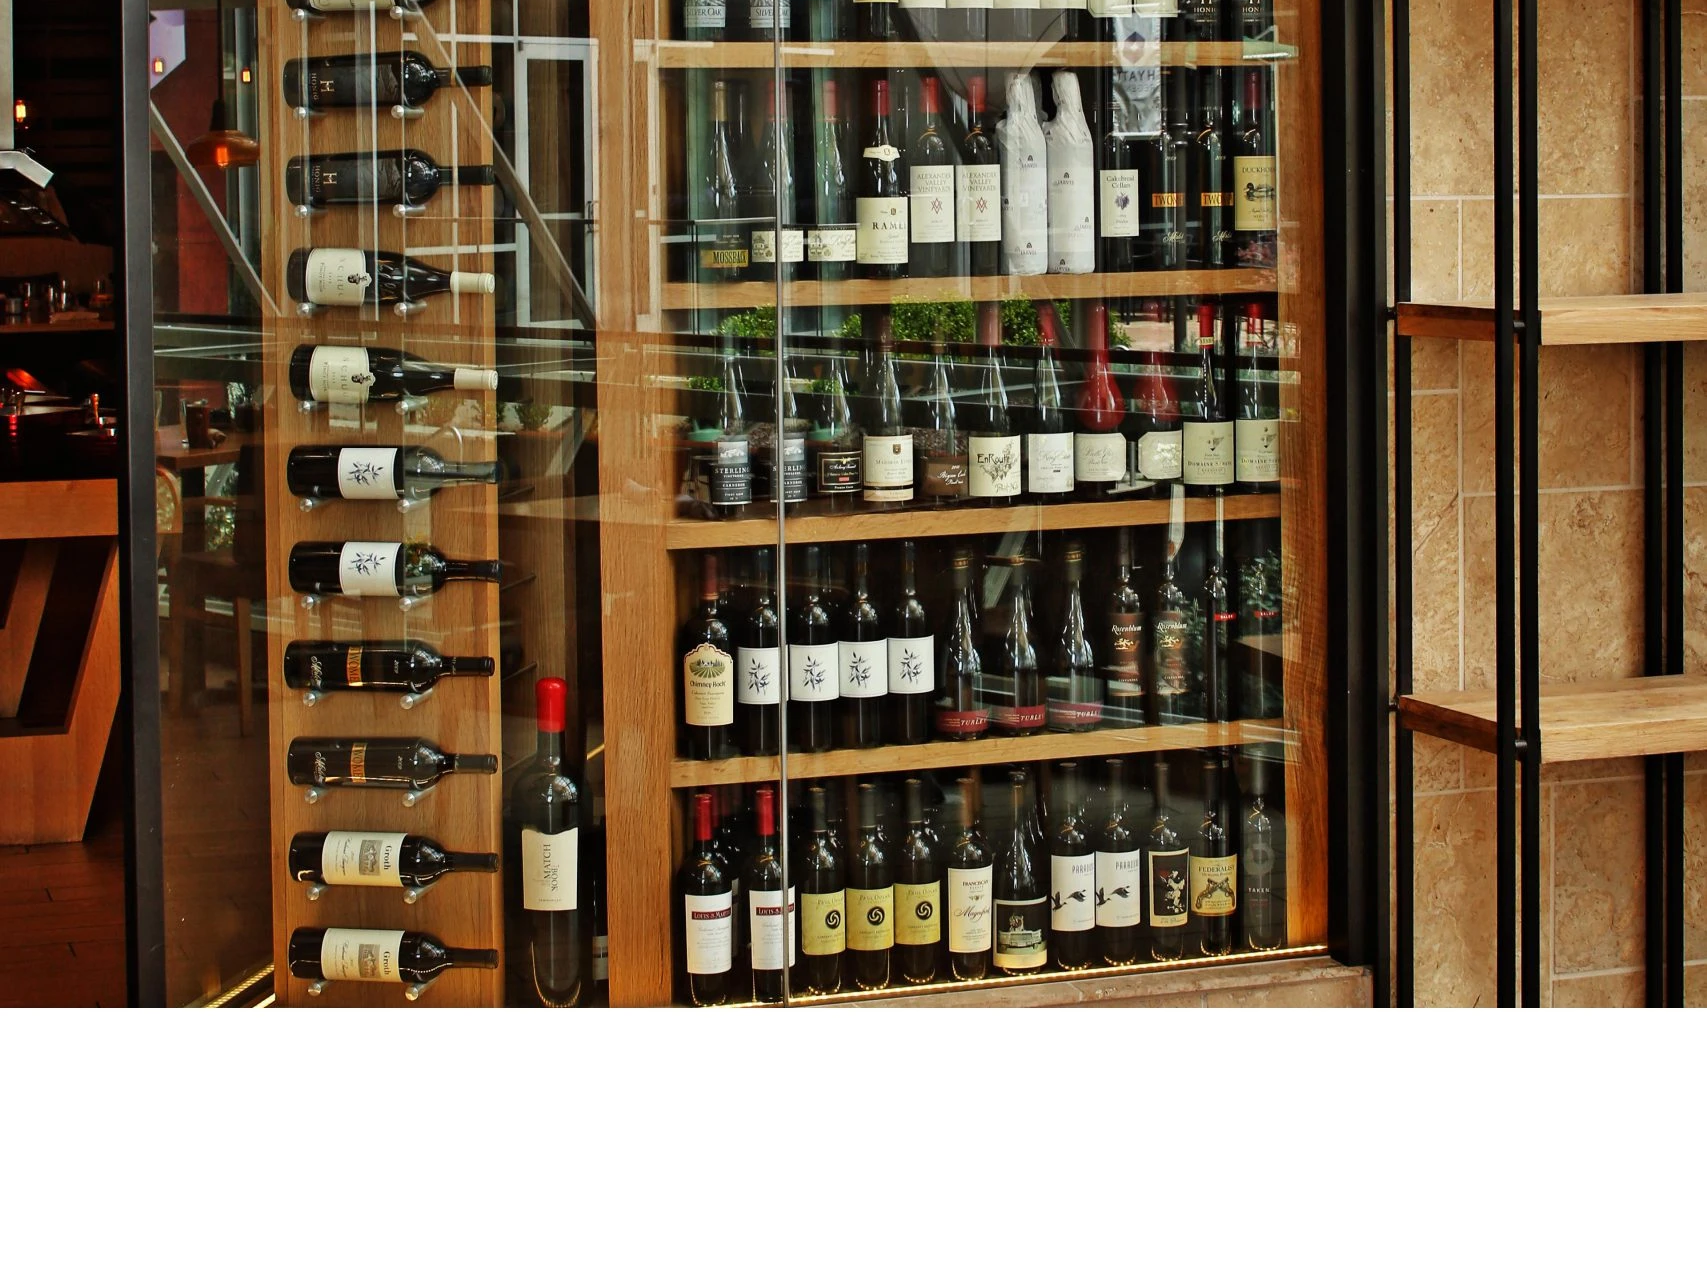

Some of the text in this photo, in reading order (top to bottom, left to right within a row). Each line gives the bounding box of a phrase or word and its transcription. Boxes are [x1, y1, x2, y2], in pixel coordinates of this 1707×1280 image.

[755, 8, 776, 17] SILVE
[384, 845, 393, 871] Groth
[543, 844, 552, 879] MATCH
[383, 951, 391, 976] Groth
